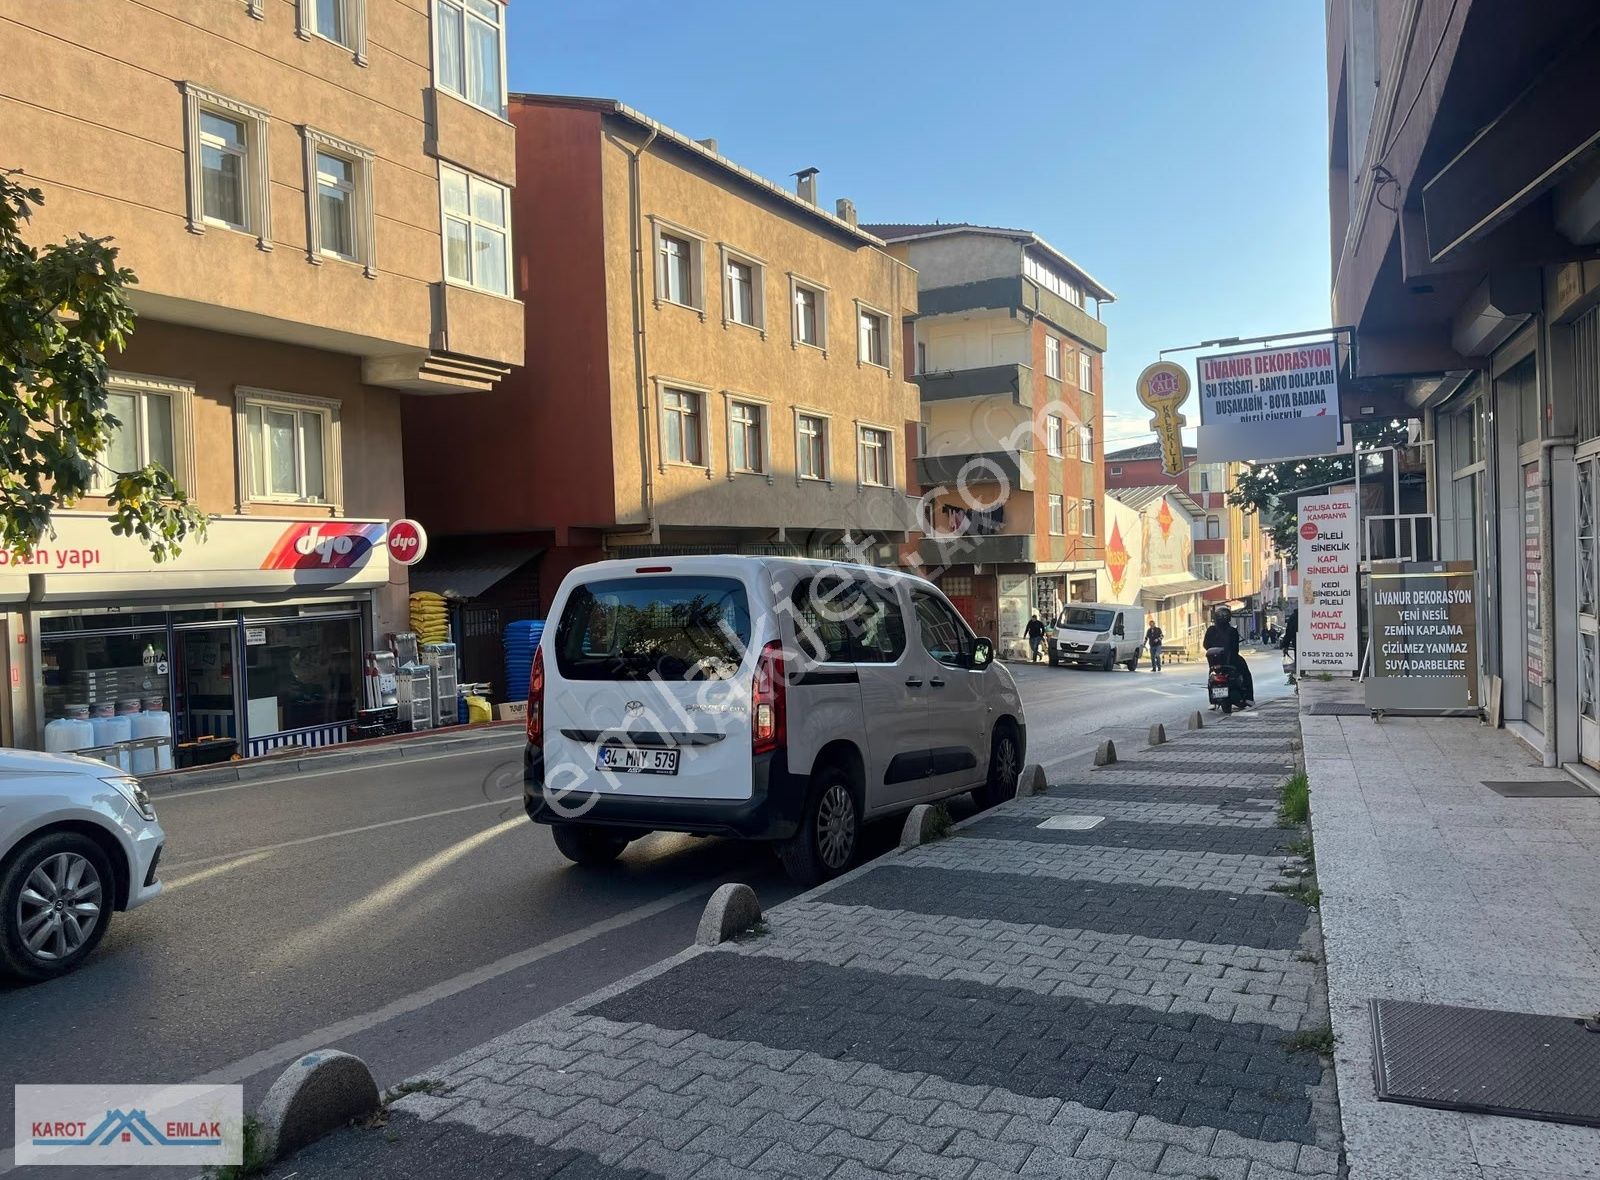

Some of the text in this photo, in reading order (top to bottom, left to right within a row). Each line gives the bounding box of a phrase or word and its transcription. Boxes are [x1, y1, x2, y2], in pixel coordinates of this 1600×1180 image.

[1204, 348, 1332, 380] LİVANUR DEKORASYON
[1206, 384, 1217, 398] SU
[1219, 379, 1254, 397] TESİSATI
[1260, 375, 1287, 392] BANYO
[1289, 370, 1334, 389] DOLAPLARI
[1215, 394, 1263, 417] DUŞAKABİN
[1269, 393, 1291, 410] BOYA
[1292, 389, 1327, 407] BADANA
[1307, 512, 1347, 521] KAMPANYA
[390, 533, 417, 551] dyo
[1317, 530, 1344, 541] PİLELİ
[296, 526, 353, 563] dyo
[1311, 541, 1350, 552] SİNEKLİK
[56, 549, 100, 569] yapı
[1317, 555, 1338, 563] KAPI
[1320, 598, 1344, 606] PİLELİ
[1374, 589, 1472, 605] LİVANUR DEKORASYON
[1397, 607, 1449, 621] YENİ NESİL
[1384, 623, 1463, 636] ZEMİN KAPLAMA
[1382, 641, 1468, 657] ÇİZİLMEZ YANMAZ
[1385, 659, 1466, 670] SUYA DARBELERE
[604, 749, 676, 769] 34 MNY 579
